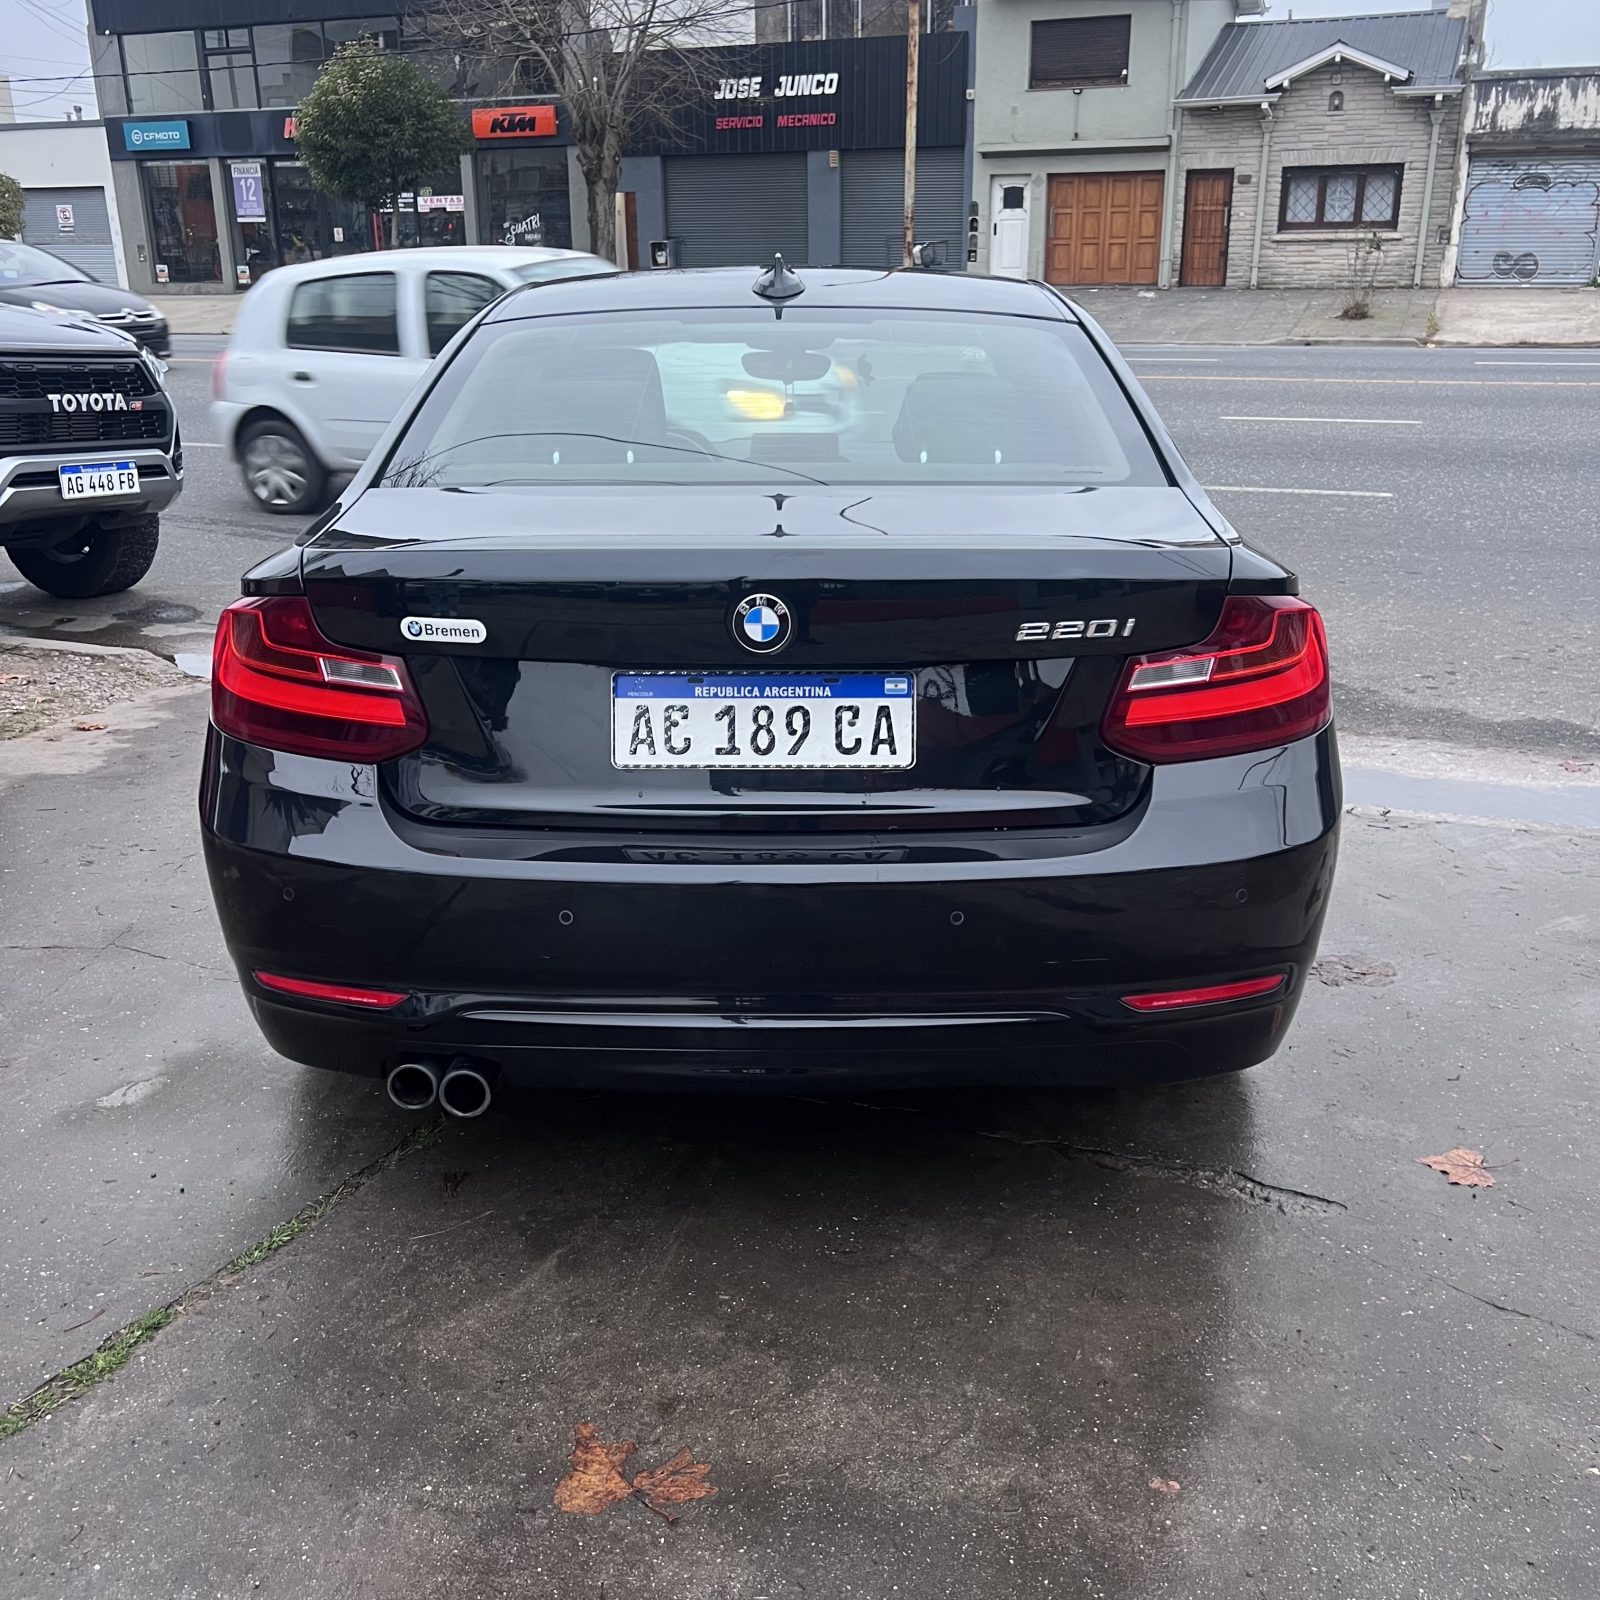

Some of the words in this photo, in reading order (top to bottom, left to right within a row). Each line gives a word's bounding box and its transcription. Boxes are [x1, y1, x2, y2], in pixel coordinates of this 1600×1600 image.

[713, 76, 763, 100] JOSE
[774, 72, 840, 97] JUNCO
[489, 113, 537, 134] KTM
[715, 115, 764, 130] SERVICIO
[776, 112, 837, 128] MECANICO
[143, 131, 181, 141] CFMOTO
[240, 178, 257, 201] 12
[47, 392, 128, 413] TOYOTA
[67, 476, 84, 495] AG
[89, 474, 114, 493] 448
[118, 473, 135, 490] FB
[738, 596, 787, 616] BMW
[424, 623, 480, 638] Bremen
[1015, 618, 1136, 641] 220i
[694, 686, 760, 697] REPUBLICA
[763, 686, 832, 697] ARGENTINA
[628, 704, 693, 756] AC
[714, 704, 811, 756] 189
[834, 704, 898, 756] CA
